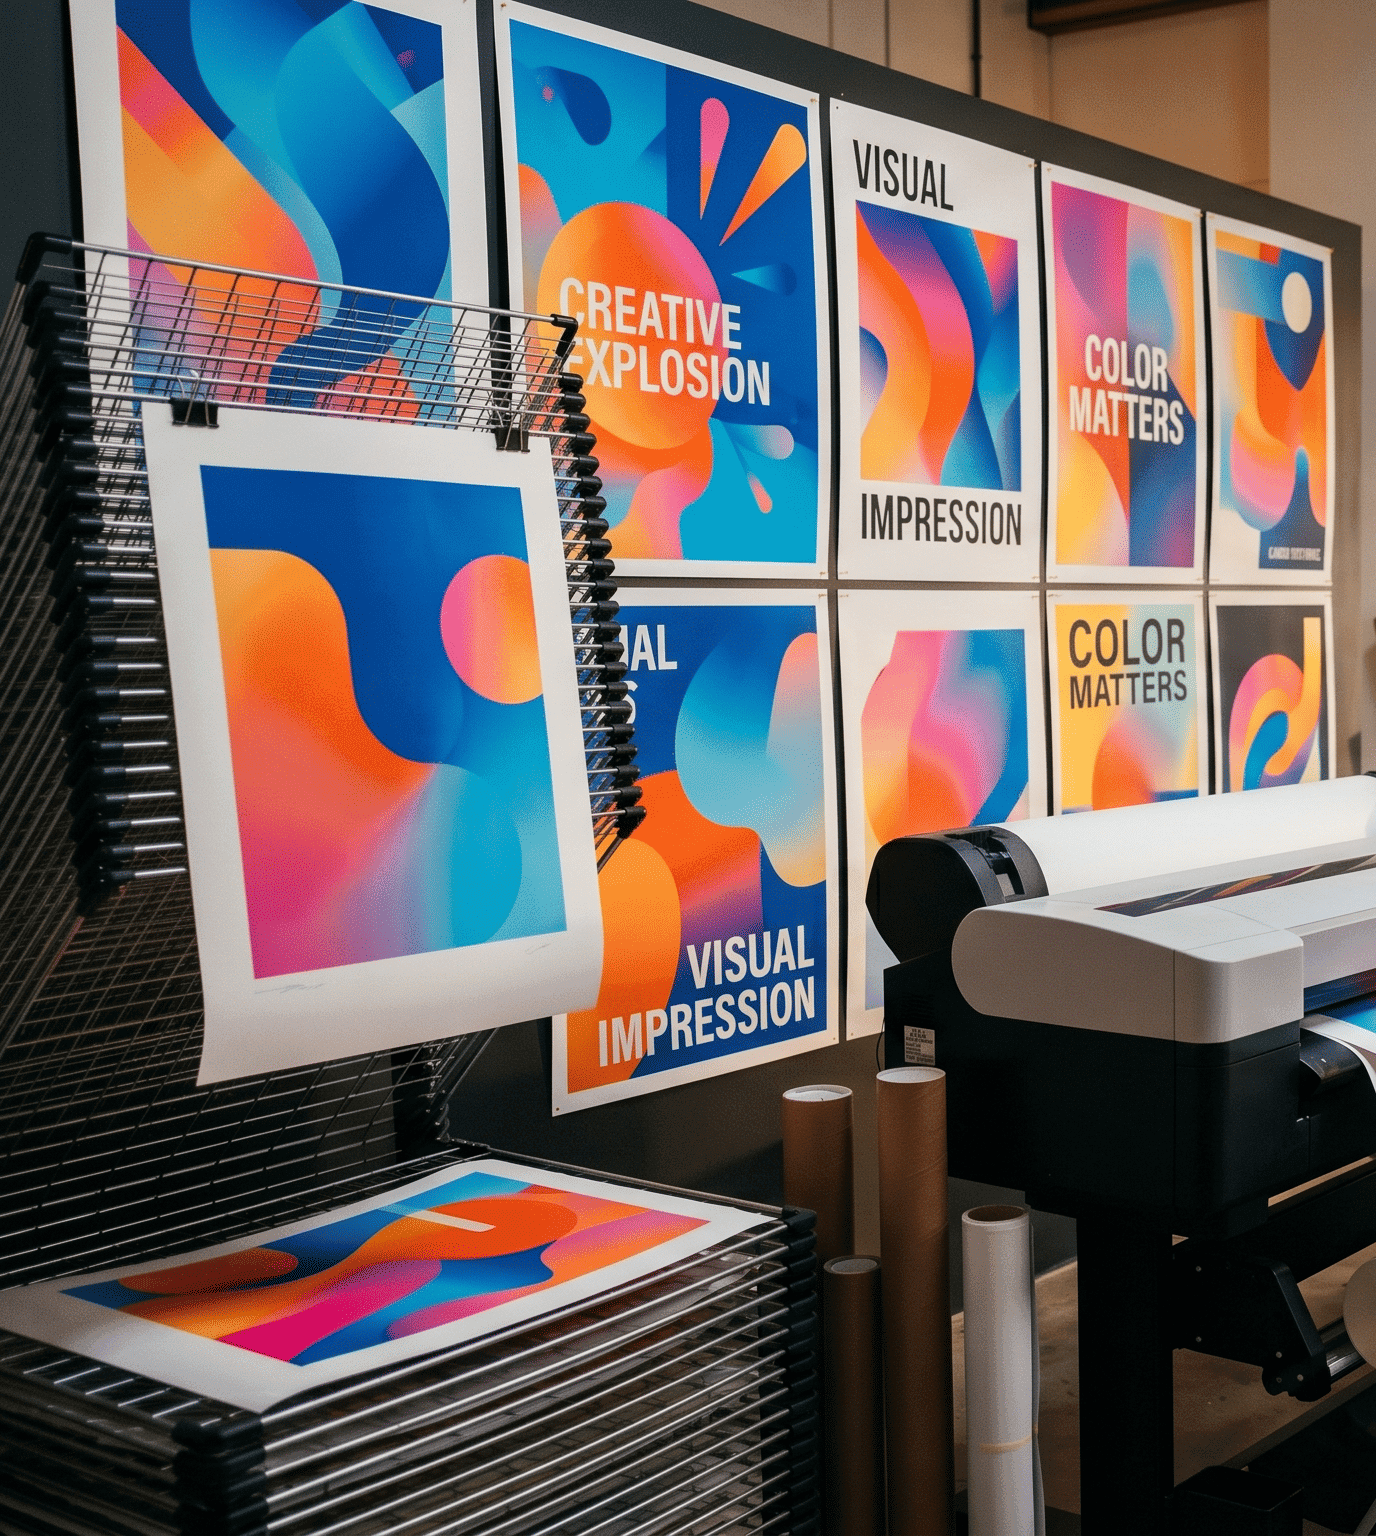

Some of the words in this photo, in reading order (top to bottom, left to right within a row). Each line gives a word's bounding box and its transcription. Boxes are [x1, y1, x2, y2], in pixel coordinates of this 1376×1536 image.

[852, 139, 954, 212] VISUAL
[559, 277, 742, 350] CREATIVE
[1085, 333, 1168, 393] COLOR
[1069, 384, 1185, 446] MATTERS
[861, 493, 1022, 546] IMPRESSION
[1069, 618, 1186, 669] COLOR
[1069, 669, 1188, 710] MATTERS
[686, 924, 815, 989] VISUAL
[598, 975, 815, 1068] IMPRESSION
